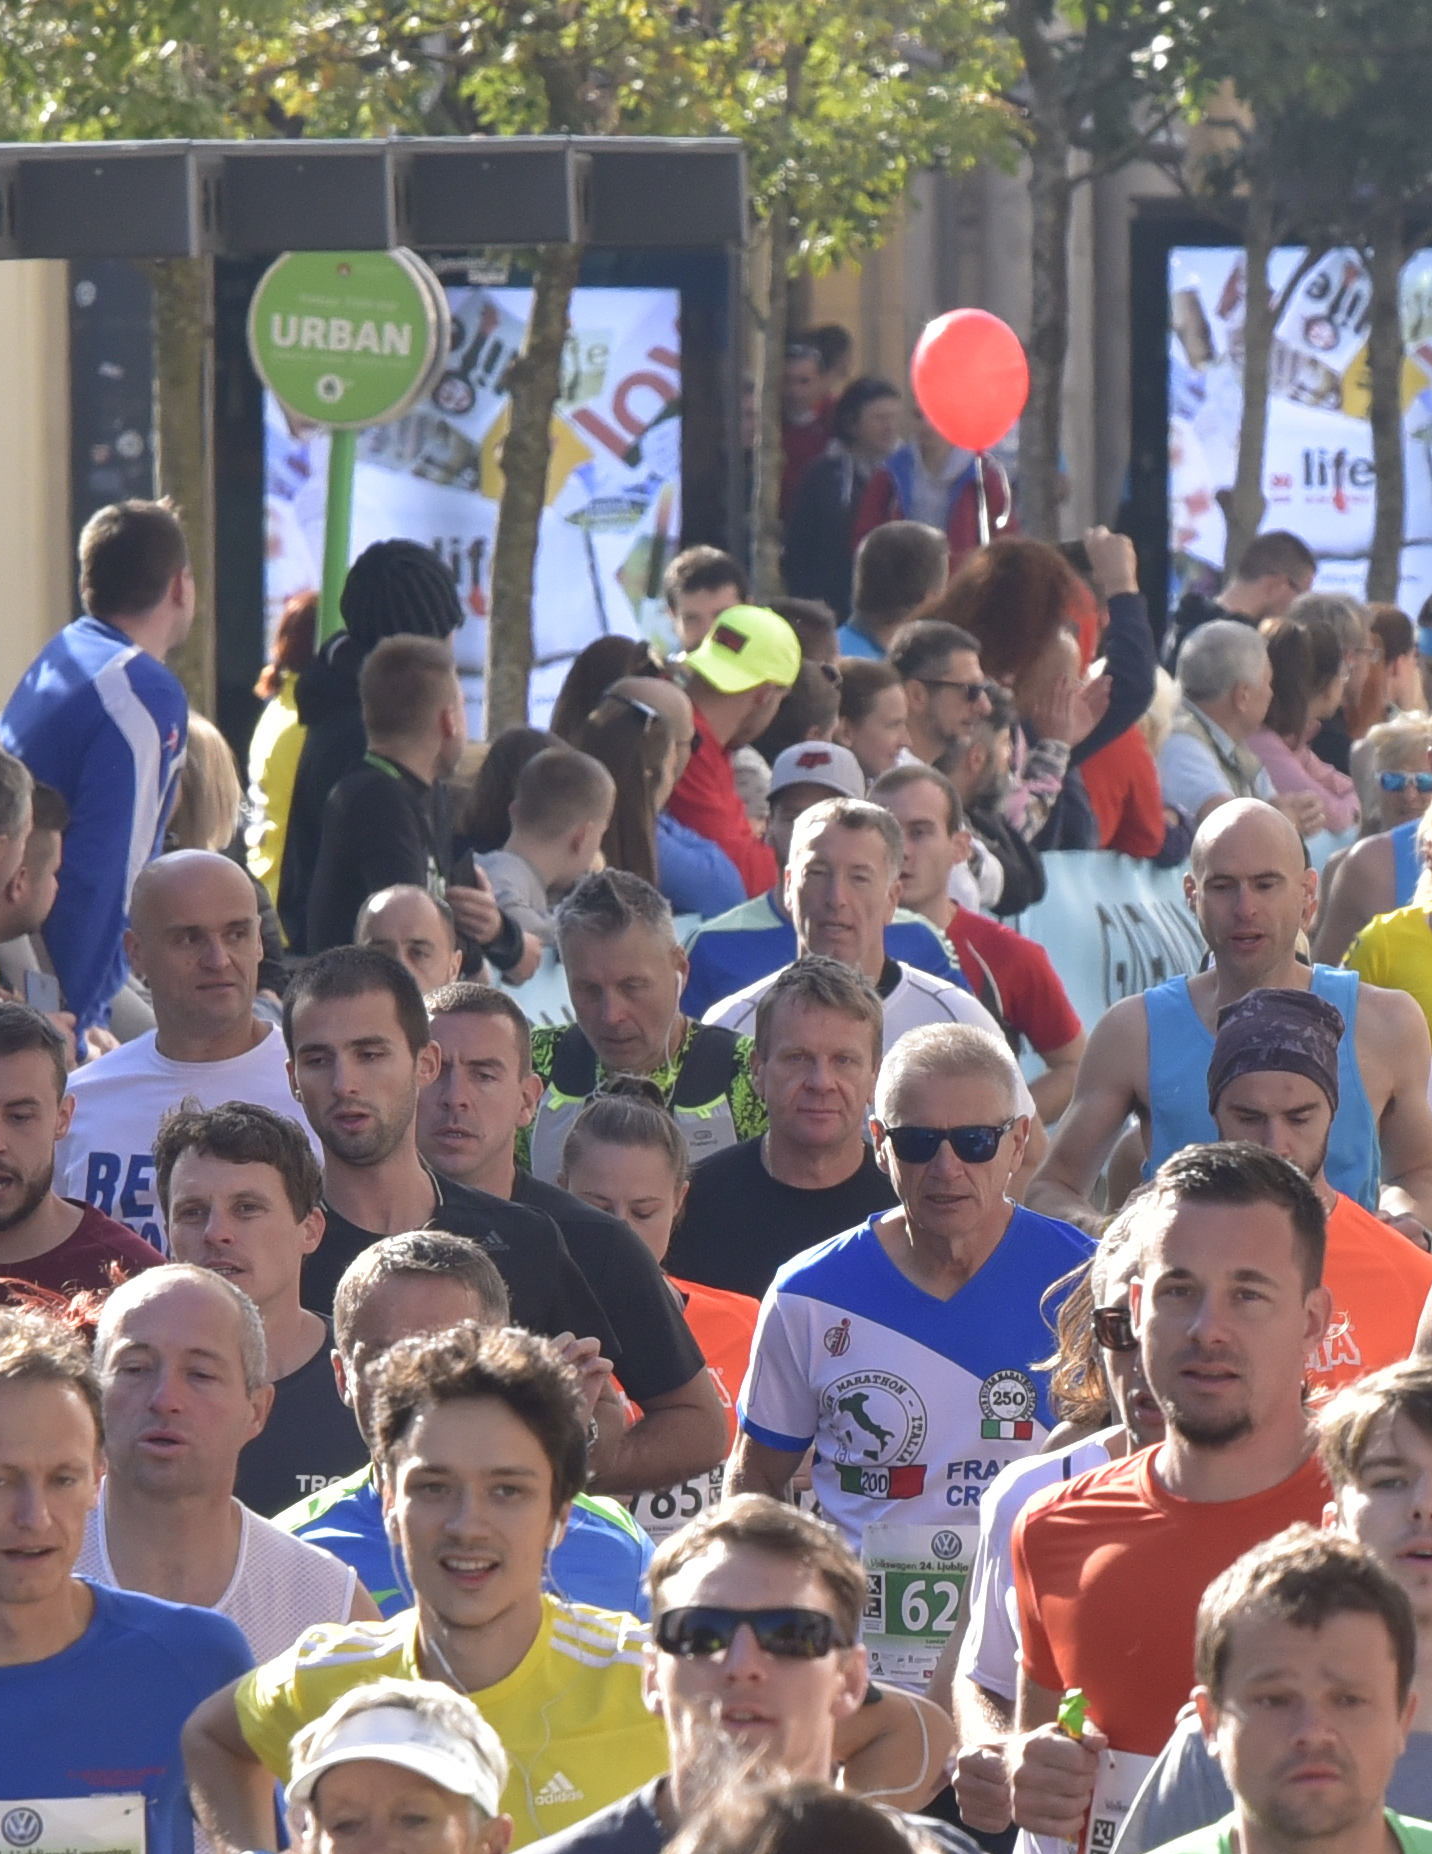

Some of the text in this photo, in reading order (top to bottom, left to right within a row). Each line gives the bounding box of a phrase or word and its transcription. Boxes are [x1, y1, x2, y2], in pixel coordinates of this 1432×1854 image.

[270, 312, 413, 356] URBAN
[834, 1370, 910, 1397] MARATHON
[992, 1391, 1025, 1407] 250
[859, 1467, 889, 1496] 200
[947, 1459, 1014, 1480] FRA
[919, 1561, 937, 1575] 24.
[901, 1580, 961, 1632] 62
[535, 1789, 585, 1806] adidas
